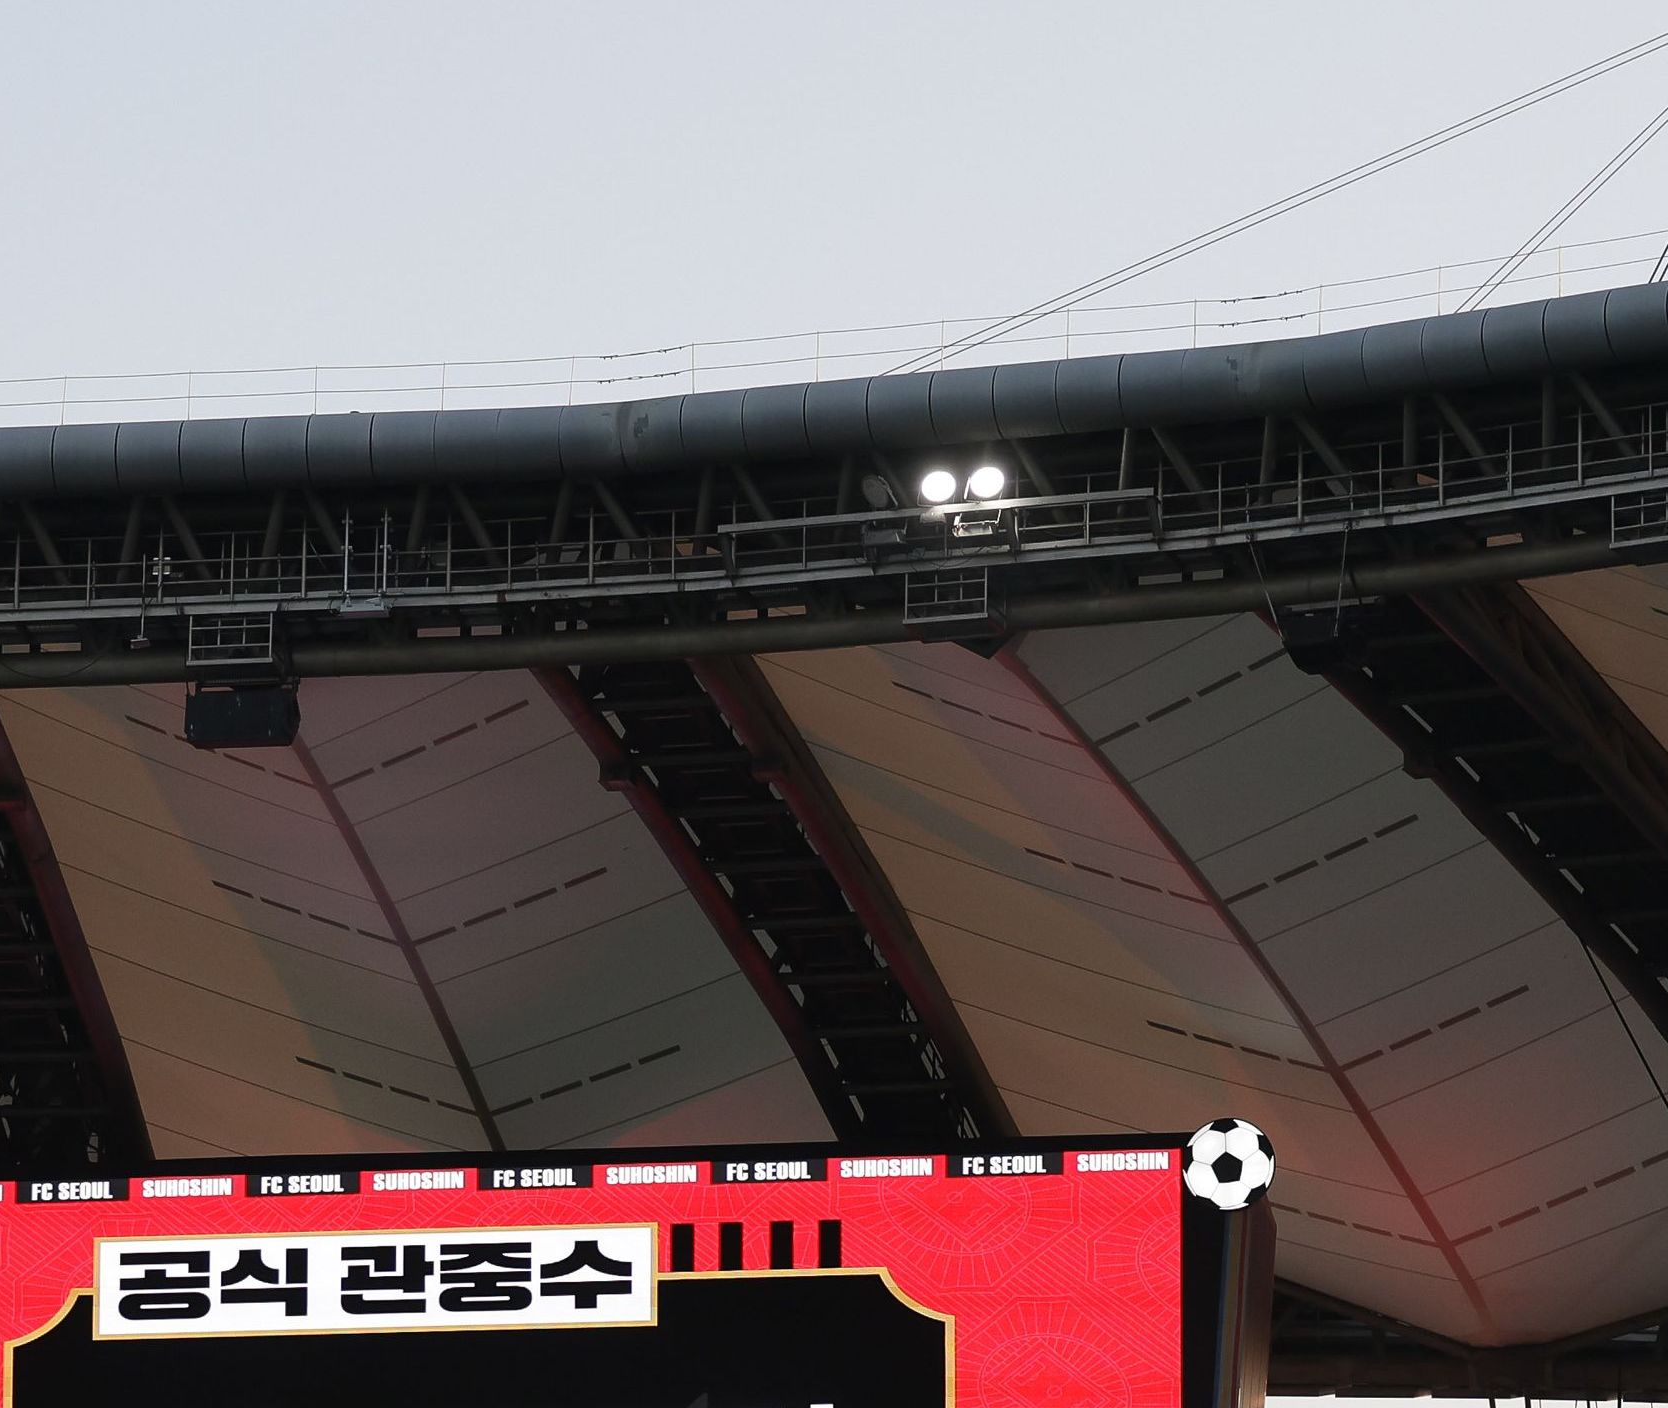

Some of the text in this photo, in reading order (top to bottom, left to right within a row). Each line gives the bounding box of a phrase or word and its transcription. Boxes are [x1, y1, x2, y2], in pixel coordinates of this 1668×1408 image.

[32, 1183, 53, 1200] FC
[58, 1182, 113, 1200] SEOUL
[143, 1178, 232, 1197] SUHOSHIN
[261, 1176, 282, 1194] FC
[288, 1175, 344, 1193] SEOUL
[374, 1171, 464, 1191] SUHOSHIN
[494, 1170, 515, 1187] FC
[521, 1169, 577, 1187] SEOUL
[607, 1165, 697, 1184] SUHOSHIN
[727, 1163, 748, 1181] FC
[755, 1162, 811, 1180] SEOUL
[841, 1158, 932, 1177] SUHOSHIN
[963, 1157, 984, 1174] FC
[990, 1155, 1046, 1174] SEOUL
[1077, 1152, 1169, 1171] SUHOSHIN
[118, 1240, 633, 1320] 공식 관중수
